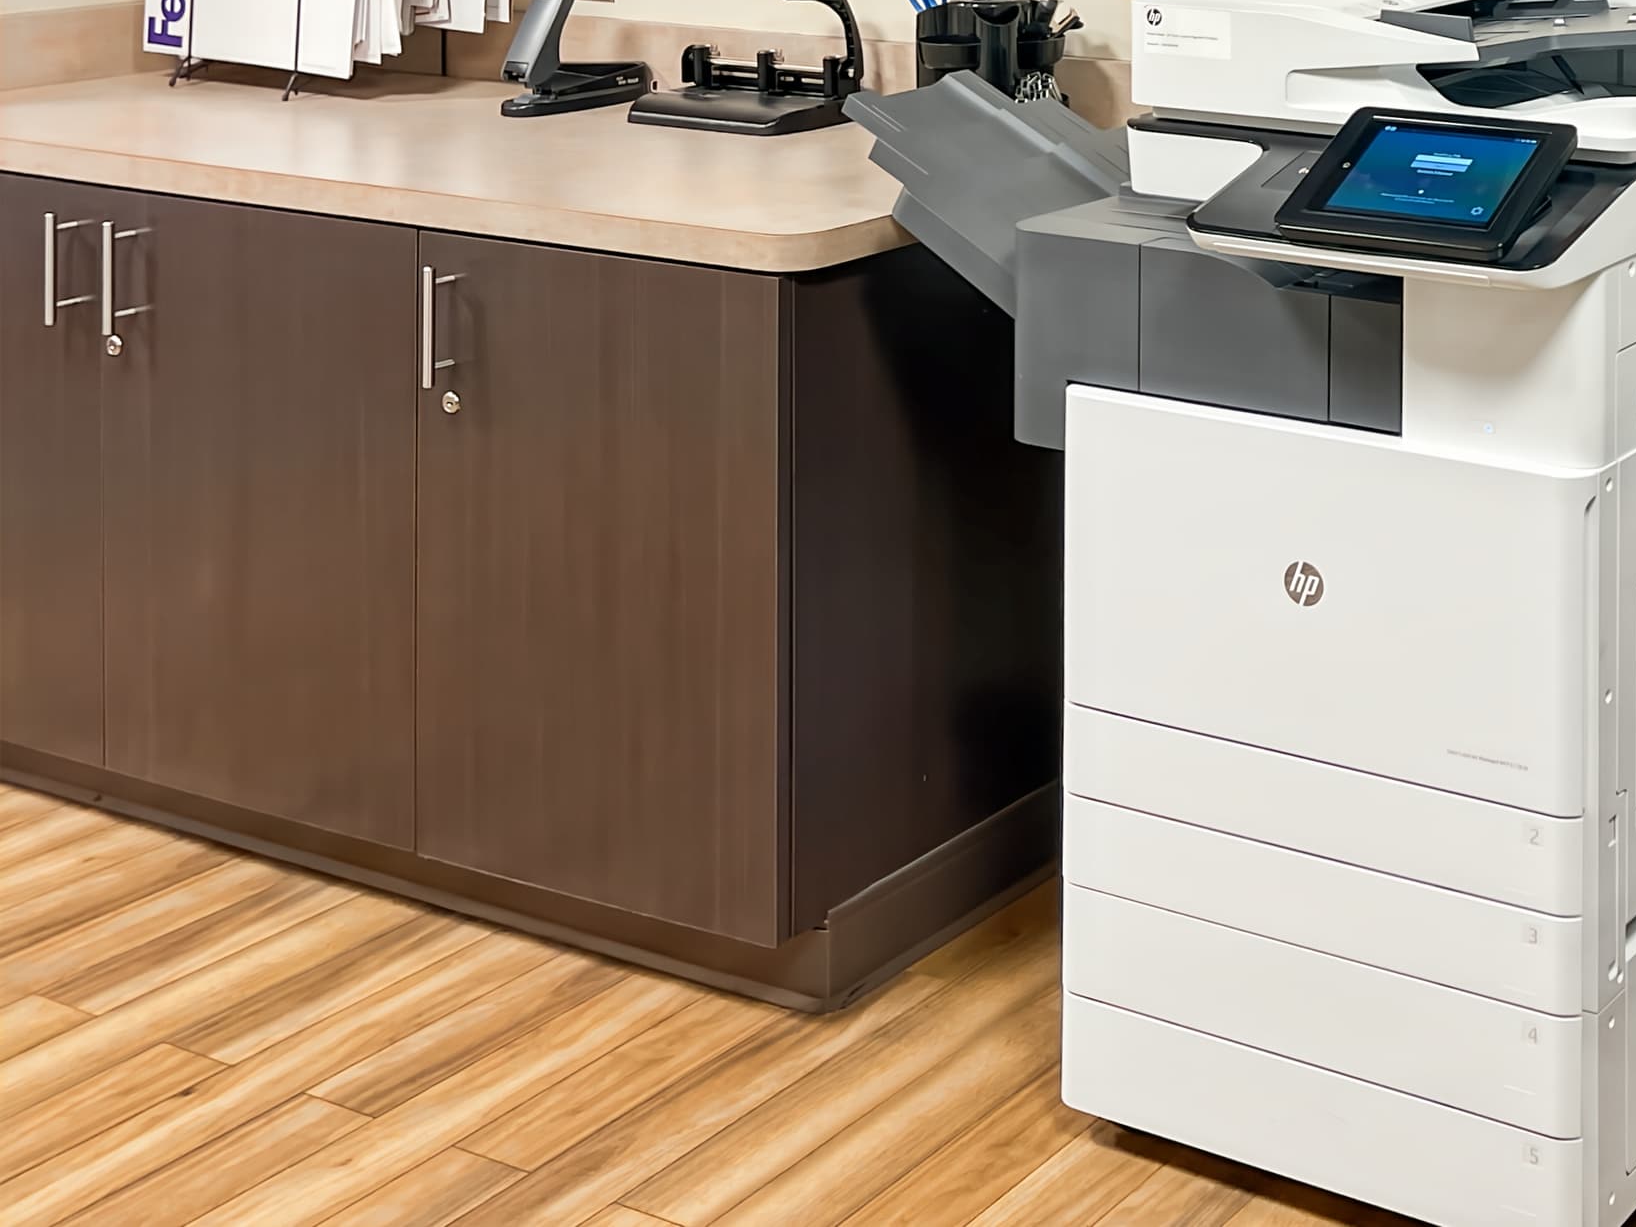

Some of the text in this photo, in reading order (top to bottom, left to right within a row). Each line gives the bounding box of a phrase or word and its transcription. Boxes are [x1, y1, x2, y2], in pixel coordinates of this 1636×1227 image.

[1147, 8, 1162, 26] hp
[1284, 560, 1324, 607] hp
[1529, 828, 1539, 846] 2
[1528, 927, 1538, 944] 3
[1527, 1027, 1537, 1044] 4
[1529, 1146, 1539, 1165] 5
